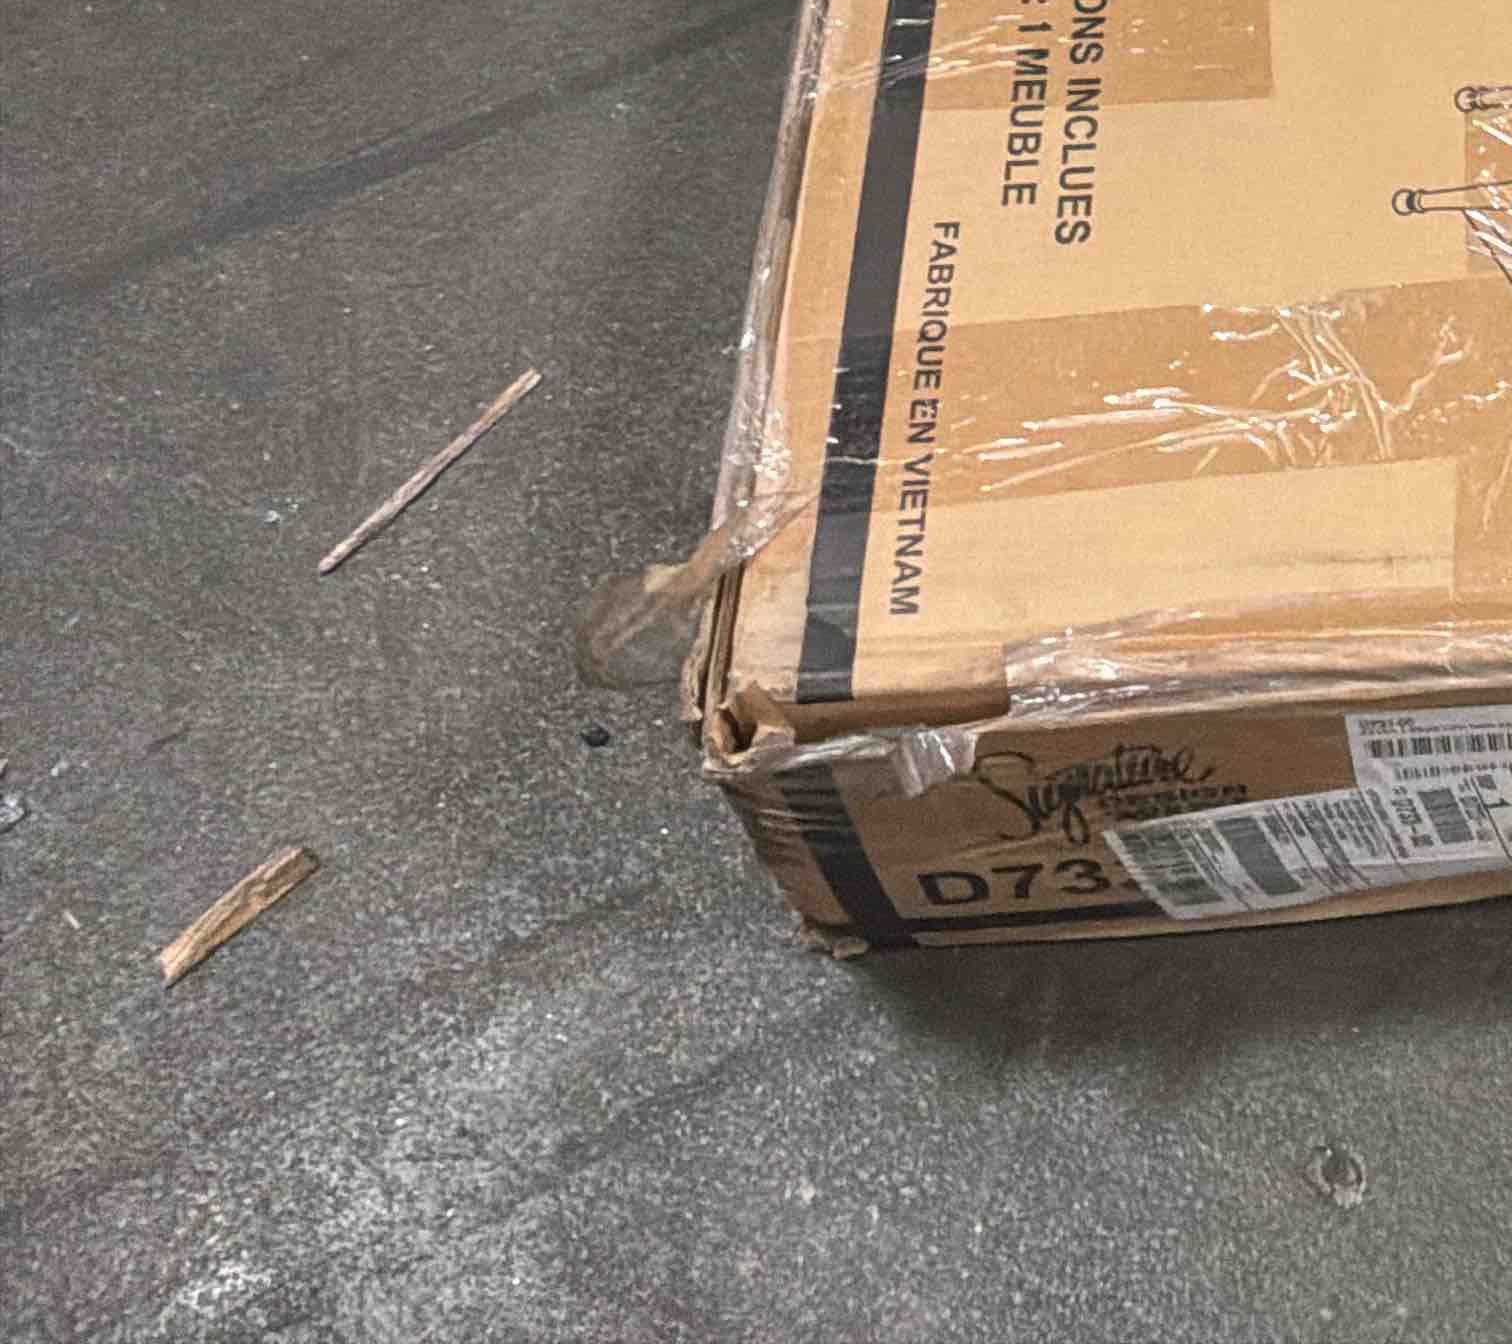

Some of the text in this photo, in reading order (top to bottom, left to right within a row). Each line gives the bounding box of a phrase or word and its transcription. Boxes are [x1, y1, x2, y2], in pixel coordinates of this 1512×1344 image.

[1017, 18, 1050, 32] 1
[1000, 45, 1050, 208] MEUBLE
[1055, 77, 1104, 247] INCLUES
[887, 219, 960, 616] FABRIQUE EN VIETNAM
[917, 857, 1138, 906] D73
